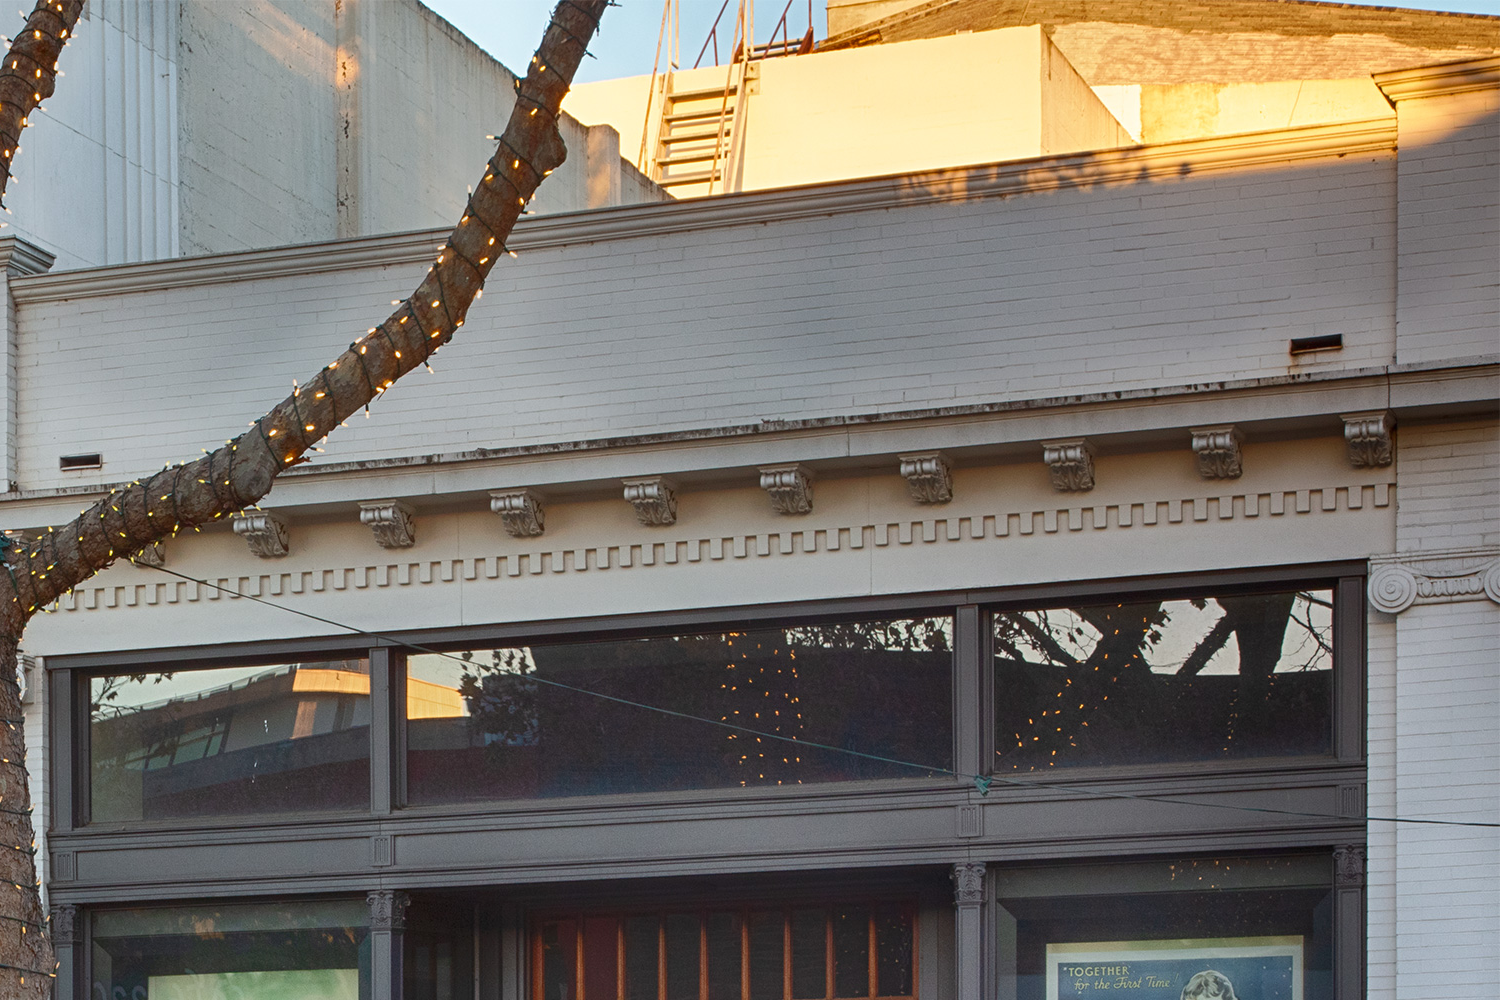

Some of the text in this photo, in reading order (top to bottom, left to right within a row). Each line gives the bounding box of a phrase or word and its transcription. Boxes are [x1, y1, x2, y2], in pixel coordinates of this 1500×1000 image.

[1068, 966, 1130, 977] TOGETHER
[1074, 978, 1090, 990] for
[1094, 978, 1110, 990] the
[1113, 976, 1142, 989] First
